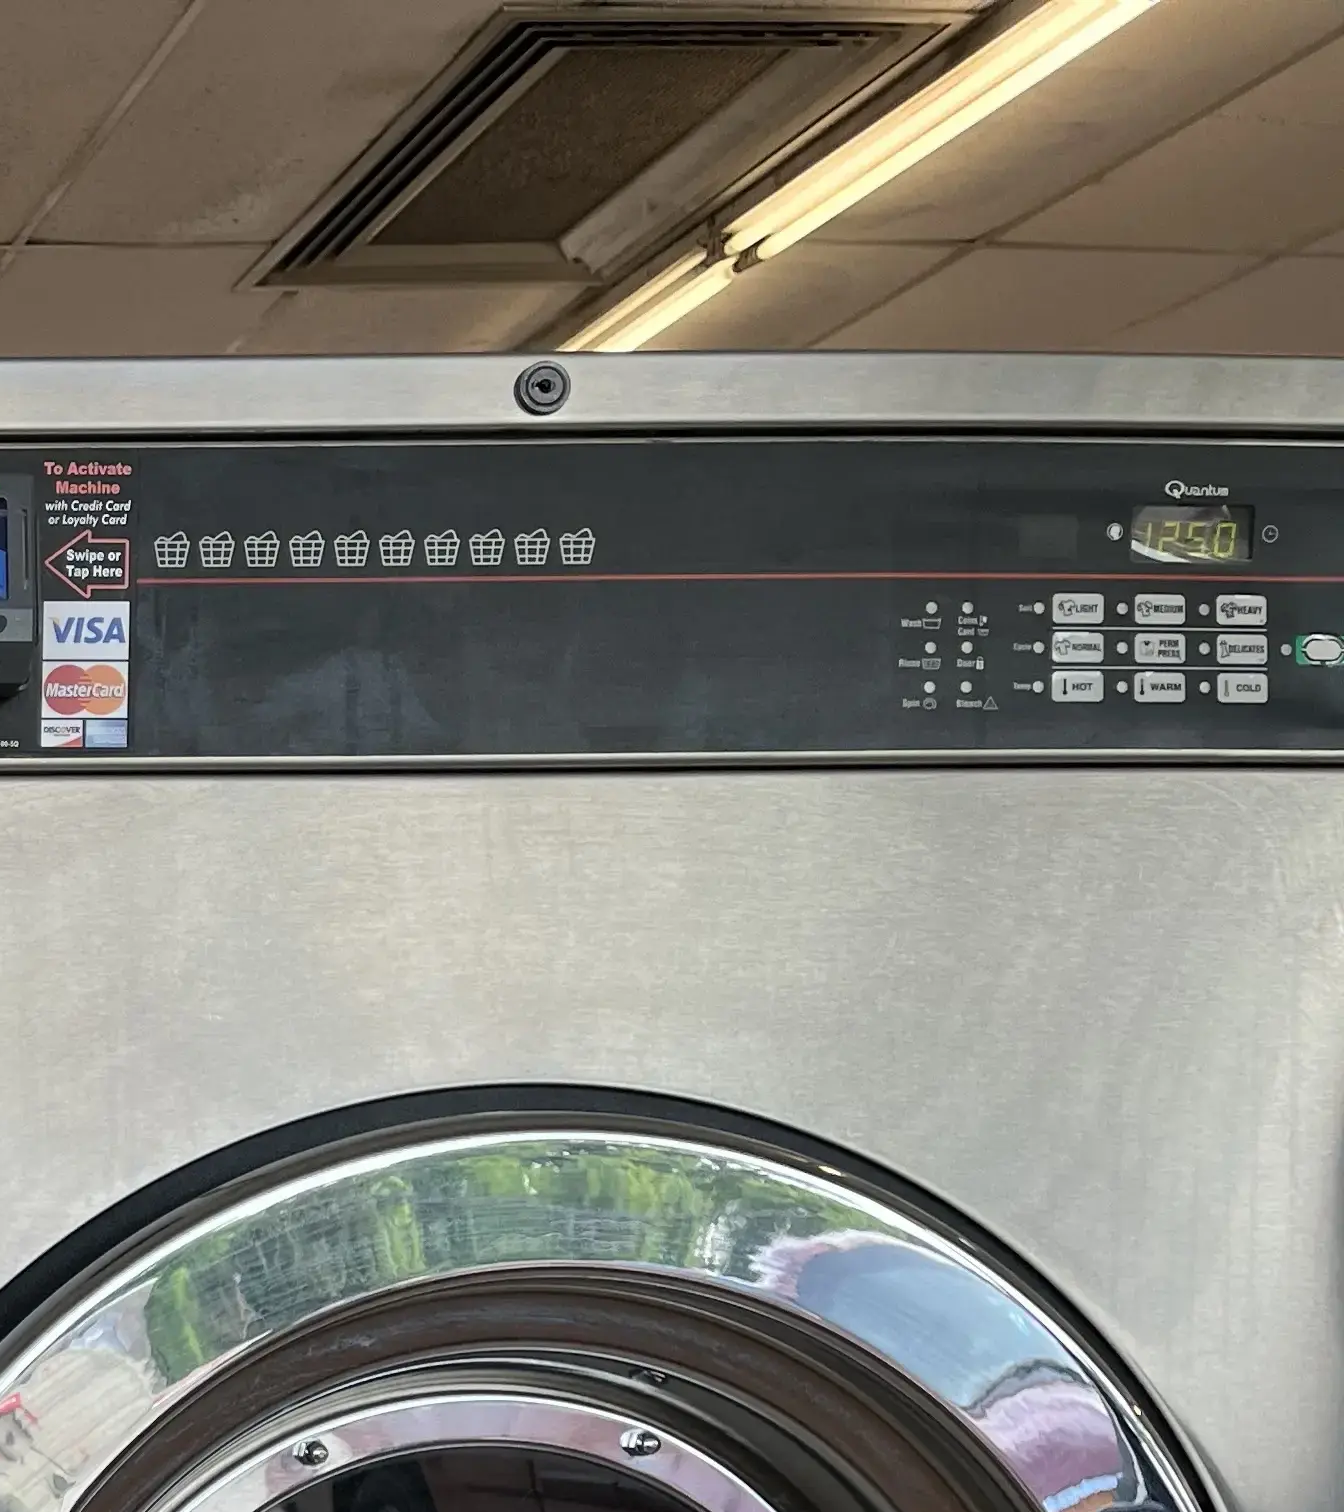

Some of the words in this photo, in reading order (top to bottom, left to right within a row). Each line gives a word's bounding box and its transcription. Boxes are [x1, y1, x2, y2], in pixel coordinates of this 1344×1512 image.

[44, 461, 63, 475] To
[67, 461, 132, 475] Activate
[55, 480, 120, 495] Machine
[1164, 480, 1229, 498] Quantum
[45, 500, 68, 511] with
[70, 500, 104, 512] Credit
[105, 499, 132, 511] Card
[48, 516, 60, 525] or
[62, 513, 99, 527] Loyalty
[101, 513, 128, 525] Card
[66, 548, 105, 564] Swipe
[107, 551, 122, 561] or
[65, 564, 90, 579] Tap
[92, 564, 123, 577] Here
[1237, 605, 1263, 615] HEAVY
[49, 616, 126, 644] VISA
[45, 682, 125, 698] MasterCard
[1072, 682, 1093, 691] HOT
[1150, 683, 1182, 691] WARM
[1236, 683, 1261, 692] COLD
[43, 726, 81, 734] DISCOVER
